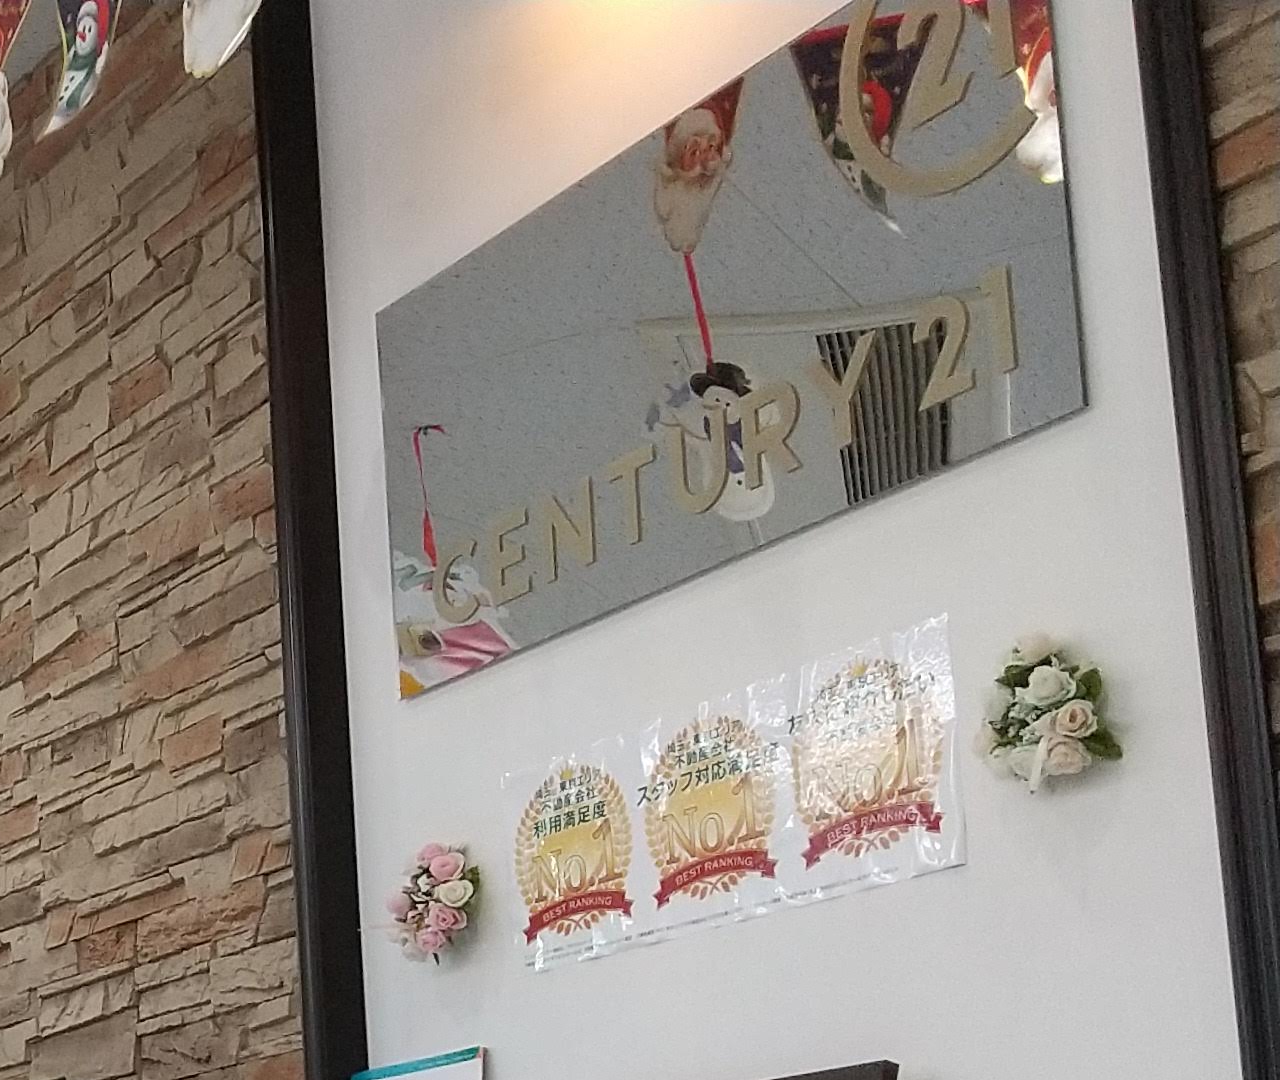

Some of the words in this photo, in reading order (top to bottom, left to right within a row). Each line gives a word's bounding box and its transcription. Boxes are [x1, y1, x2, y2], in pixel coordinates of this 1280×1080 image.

[433, 330, 877, 621] CENTURY
[912, 263, 1016, 412] 21
[533, 800, 608, 839] 利用満足度
[662, 772, 766, 865] No.1
[826, 821, 857, 844] BEST
[859, 806, 919, 829] RANKING
[532, 817, 623, 904] No.1
[675, 866, 702, 885] BEST
[704, 856, 753, 871] RANKING
[542, 905, 568, 923] BEST
[569, 895, 613, 911] RANKING
